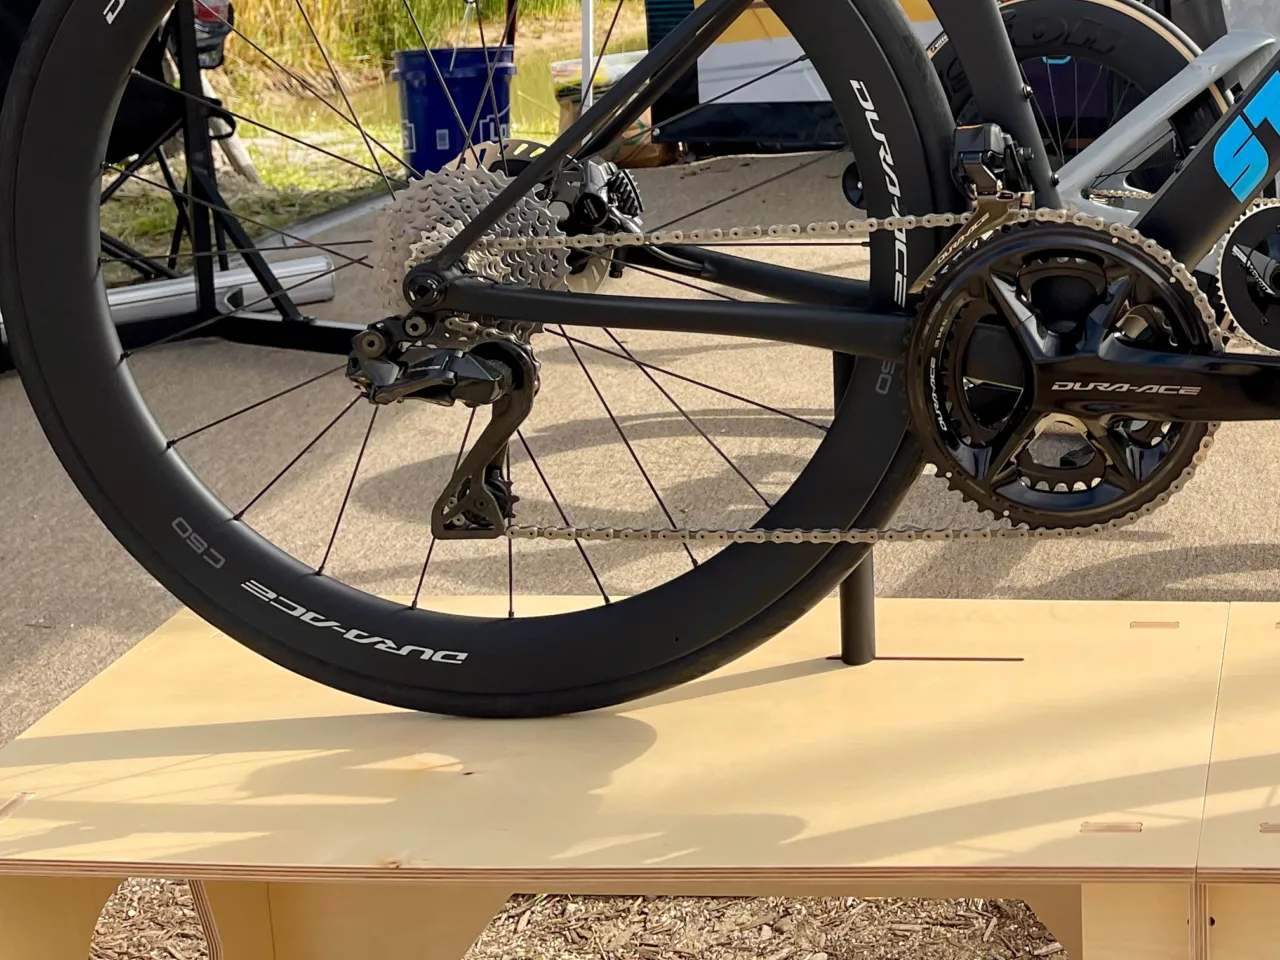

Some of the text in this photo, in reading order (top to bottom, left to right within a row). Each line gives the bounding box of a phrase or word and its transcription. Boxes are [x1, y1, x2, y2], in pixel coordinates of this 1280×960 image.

[850, 78, 909, 309] DURA-ACE
[1051, 380, 1202, 396] DURA-ACE
[172, 517, 226, 569] C50
[241, 578, 468, 665] DURA-ACE
